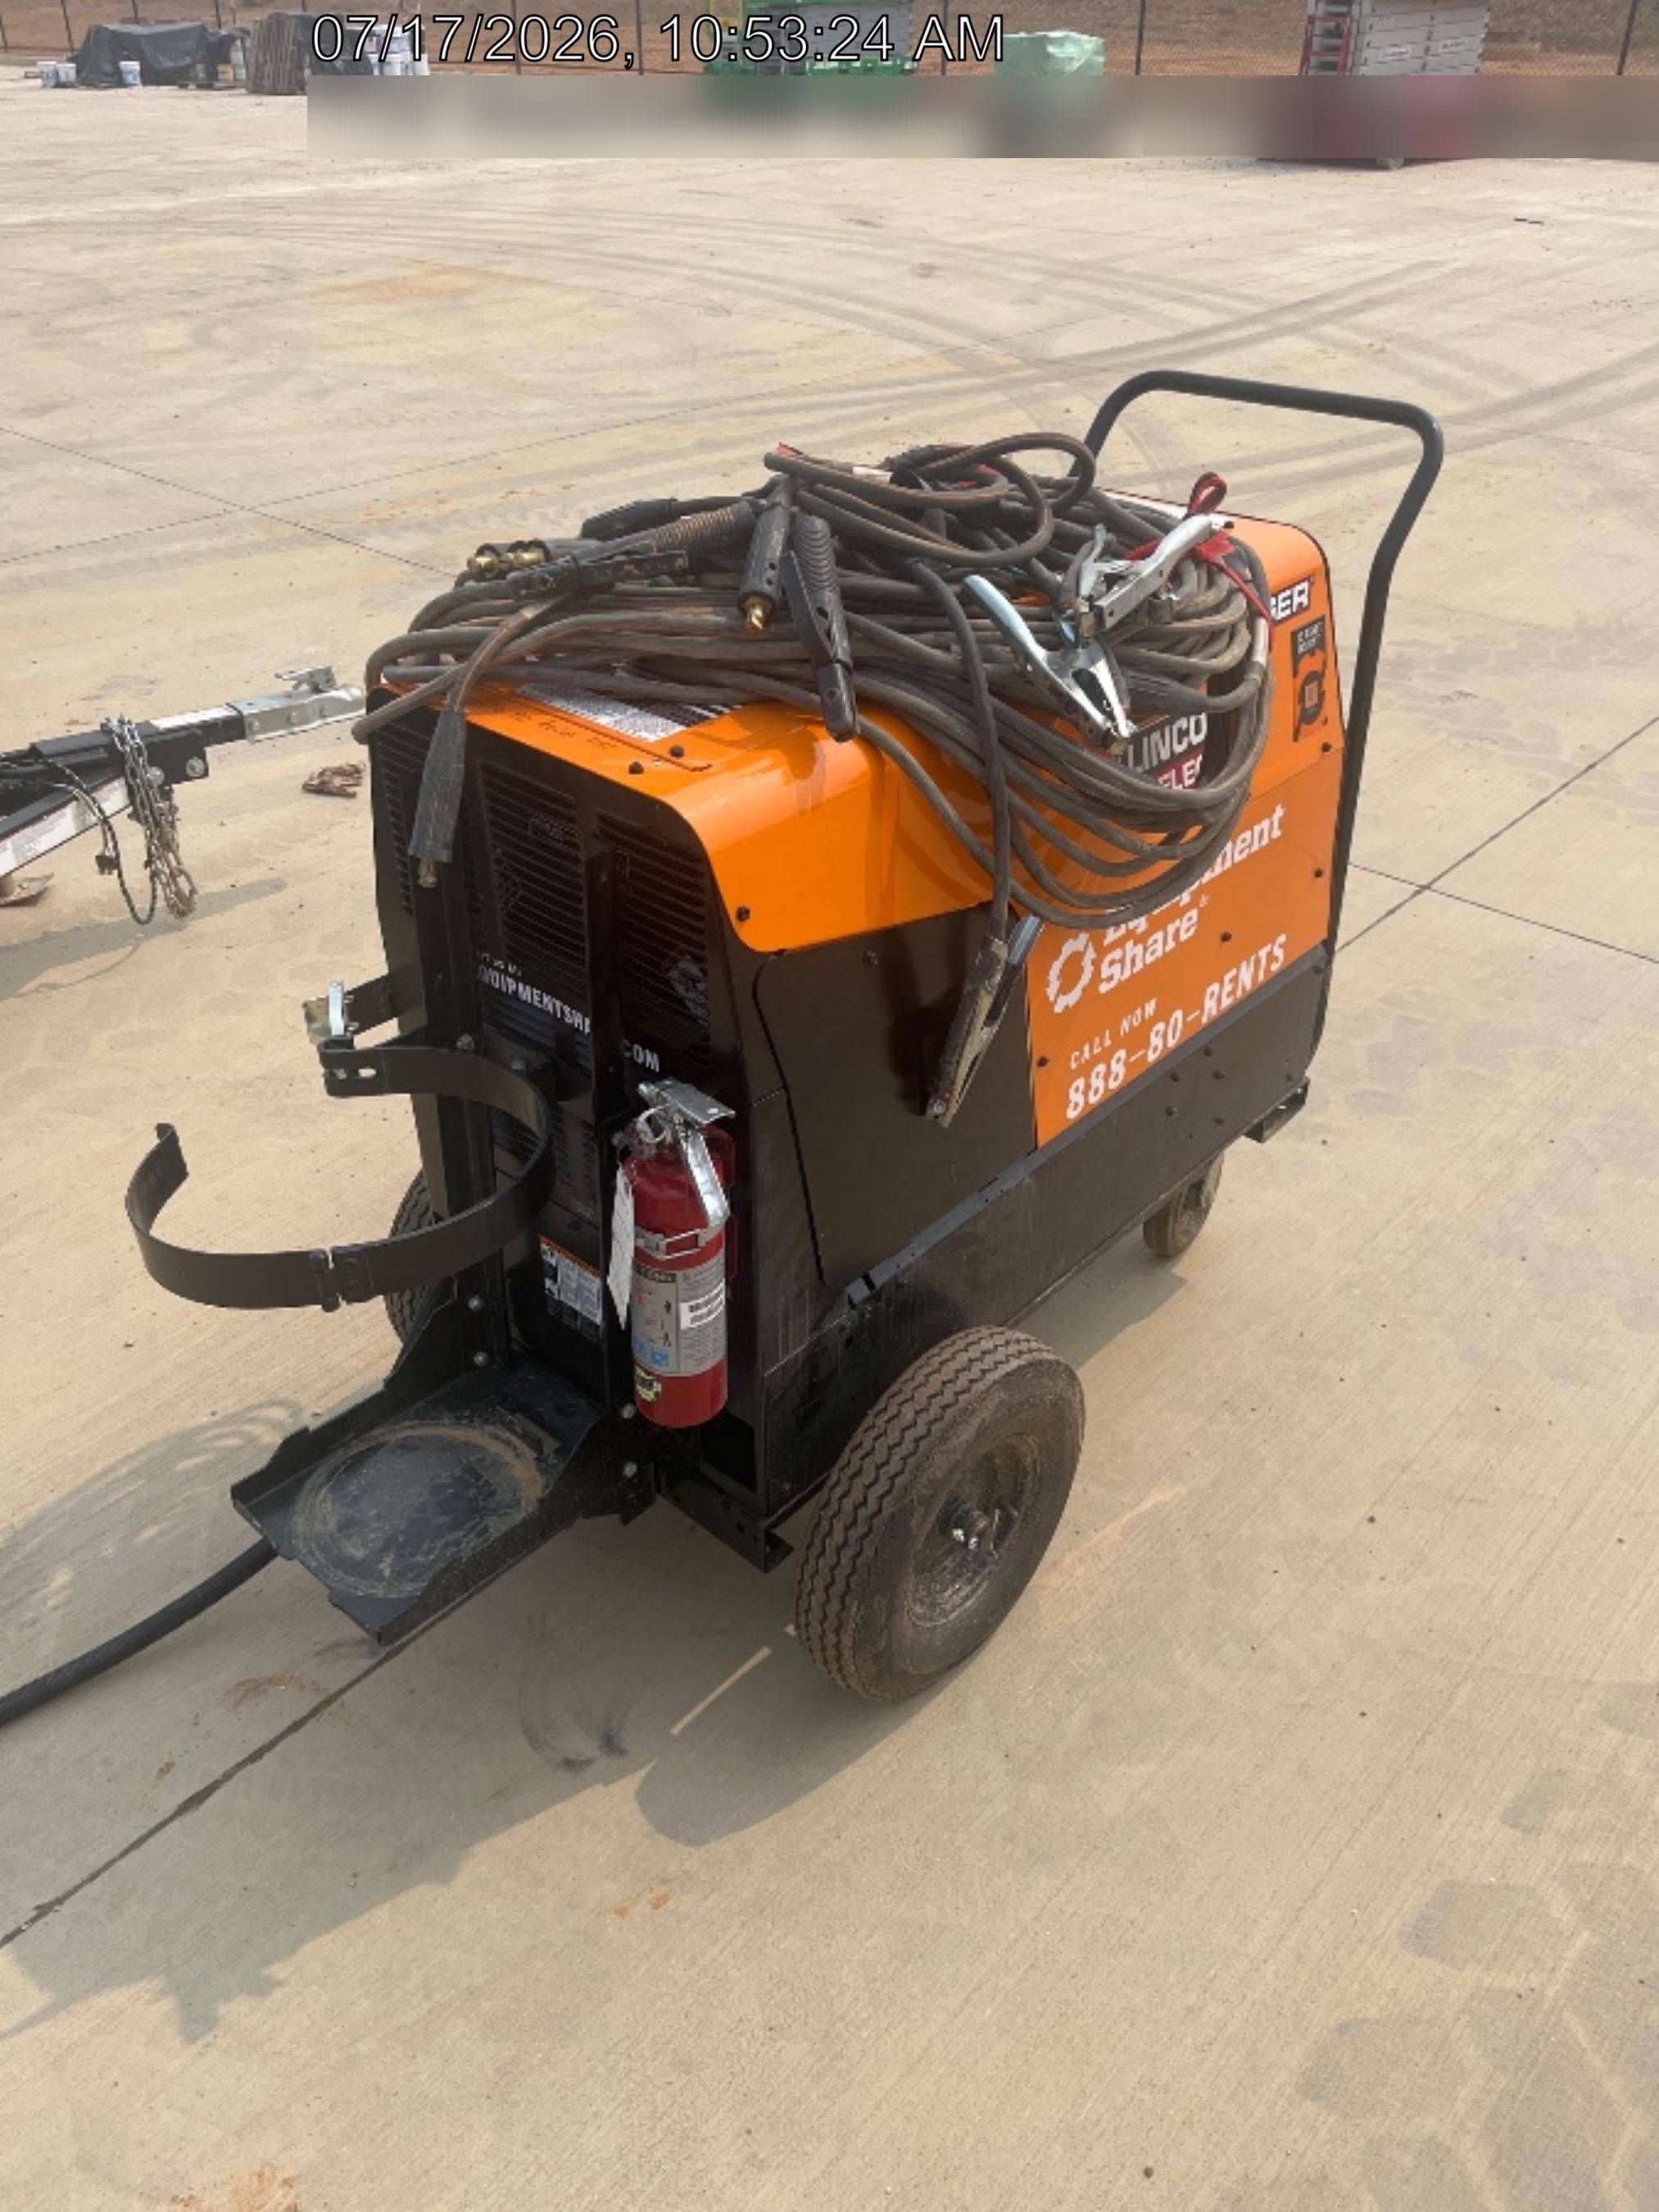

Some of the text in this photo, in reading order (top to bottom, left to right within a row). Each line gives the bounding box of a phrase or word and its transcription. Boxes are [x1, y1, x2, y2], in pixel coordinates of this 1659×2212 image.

[1098, 907, 1199, 994] Share
[1066, 933, 1286, 1120] 888-80-RENTS
[1069, 997, 1157, 1070] CALL NOW
